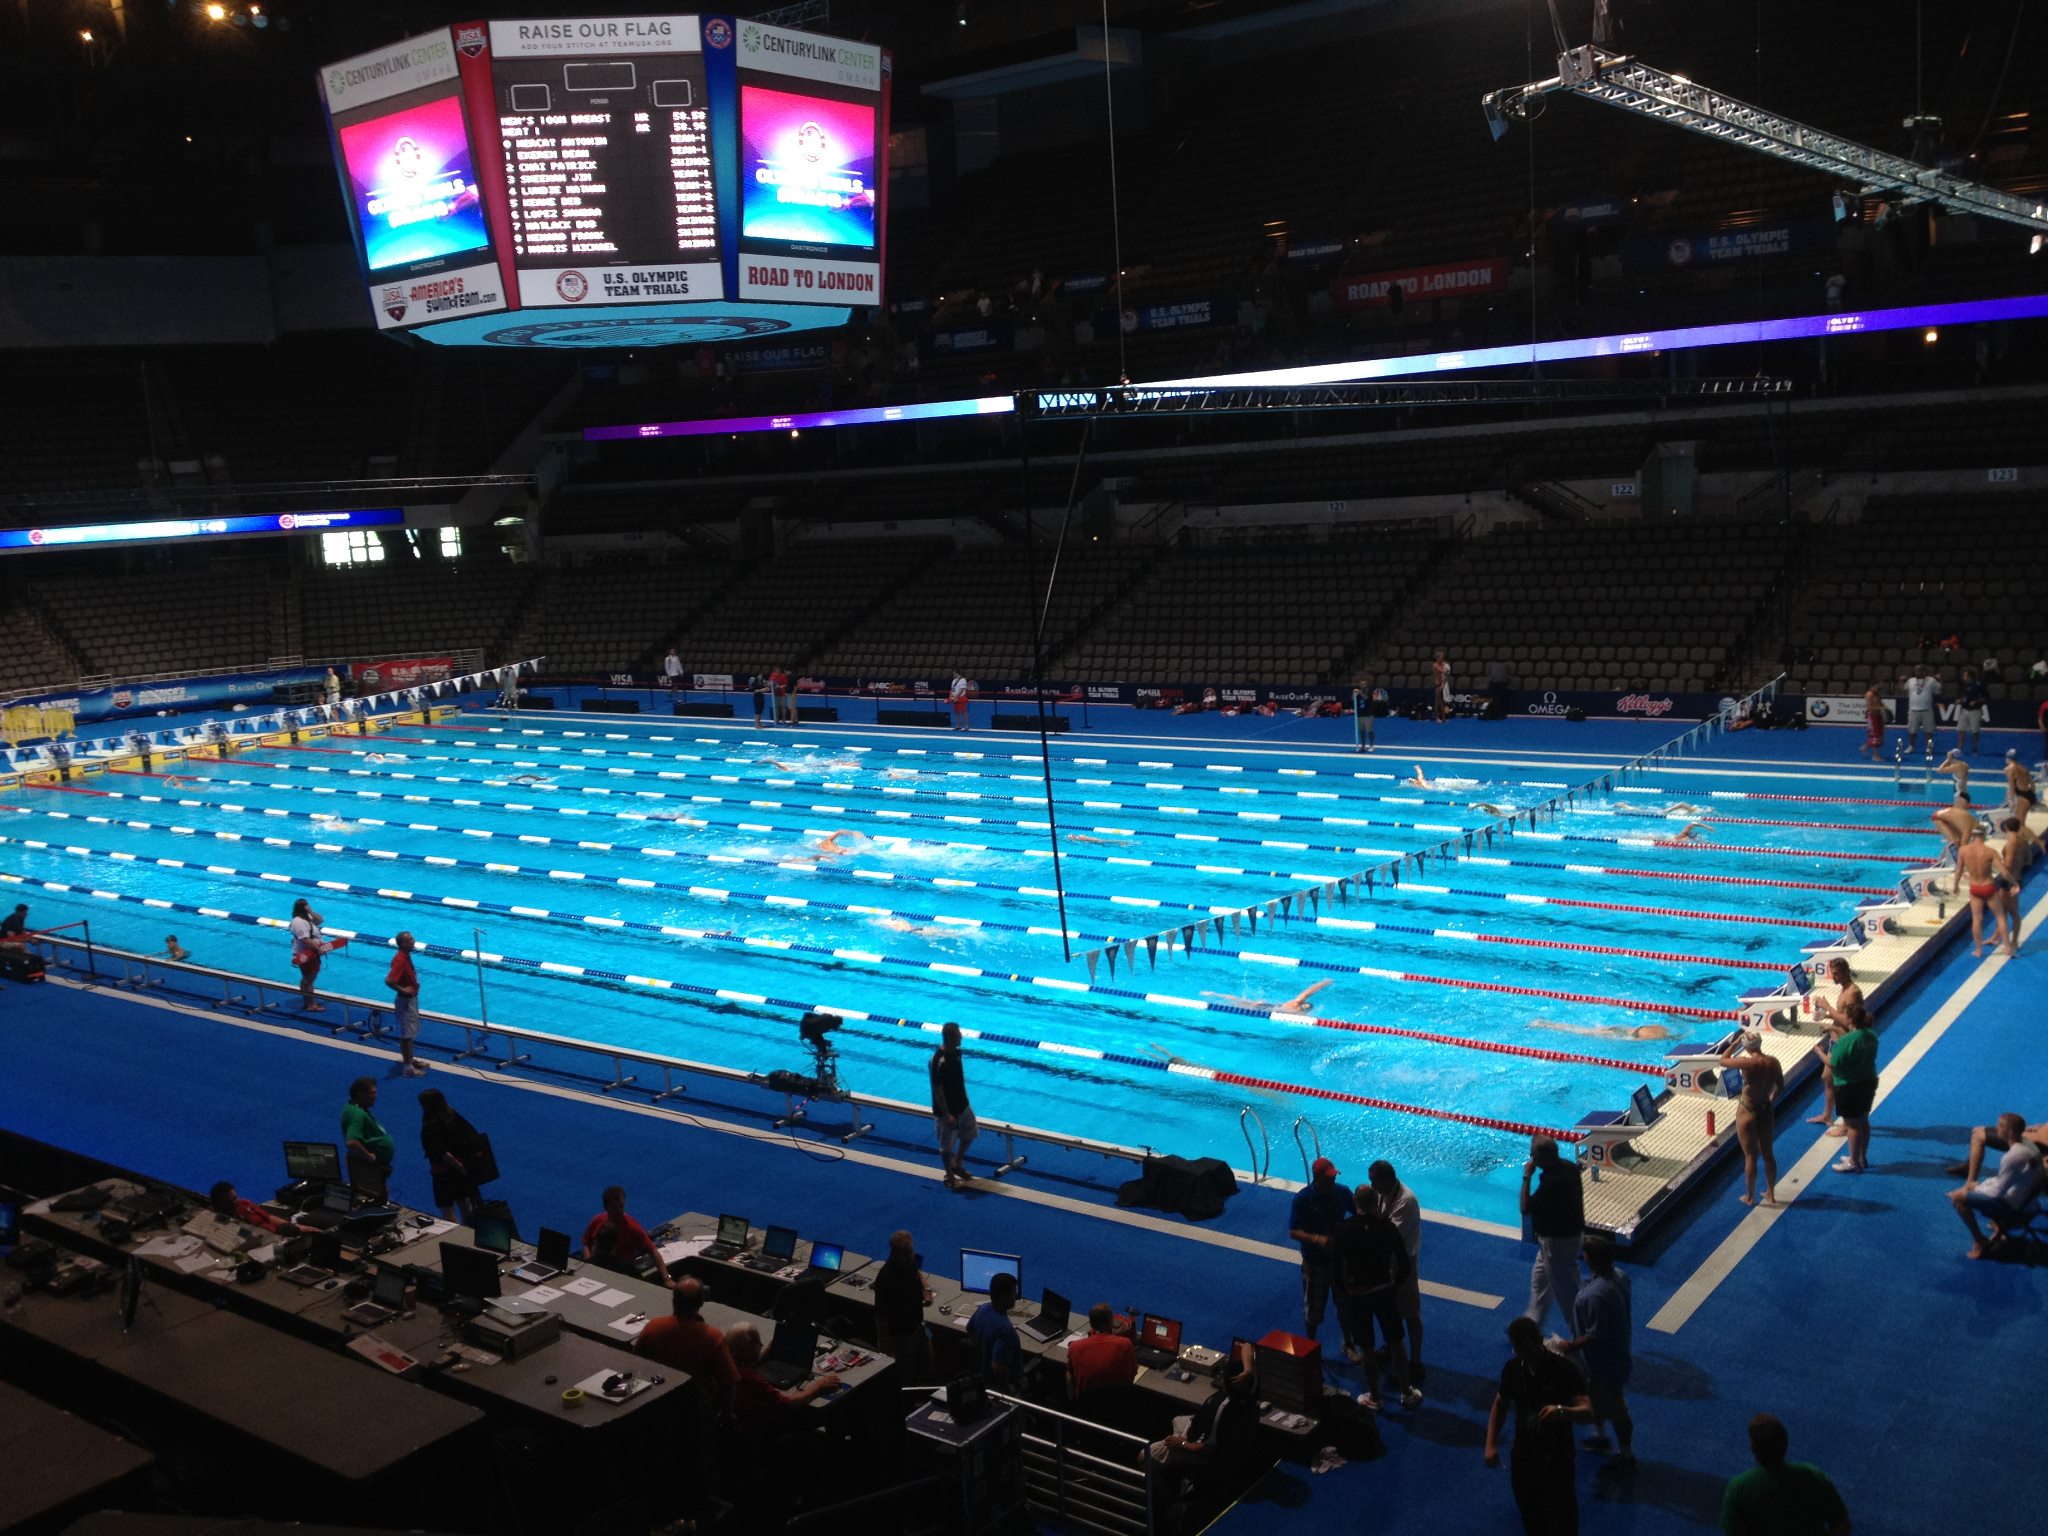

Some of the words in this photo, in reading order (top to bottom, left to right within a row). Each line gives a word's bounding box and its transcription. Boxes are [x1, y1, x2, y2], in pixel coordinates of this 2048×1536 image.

[519, 24, 573, 39] RAISE
[579, 23, 619, 37] OUR
[625, 21, 672, 36] FLAG
[410, 41, 449, 66] CENTER
[838, 48, 875, 70] CENTER
[501, 117, 534, 126] MEN'S
[571, 114, 610, 123] BREAST
[502, 127, 529, 136] HEAT
[506, 164, 514, 172] 2
[550, 161, 597, 170] PATRICK
[507, 176, 515, 184] 3
[510, 199, 518, 207] 5
[511, 211, 519, 219] 6
[524, 209, 558, 219] LOPEZ
[1709, 236, 1729, 248] U.S.
[1736, 229, 1789, 245] OLYMPIC
[515, 246, 523, 254] 9
[1710, 247, 1742, 259] TEAM
[1746, 241, 1789, 256] TRIALS
[603, 273, 628, 284] U.S.
[633, 270, 688, 283] OLYMPIC
[748, 266, 789, 286] ROAD
[794, 269, 813, 288] TO
[818, 271, 874, 291] LONDON
[1397, 278, 1418, 294] TO
[1424, 268, 1492, 291] LONDON
[410, 277, 464, 302] AMERICA'S
[604, 285, 640, 296] TEAM
[644, 283, 689, 295] TRIALS
[1150, 306, 1168, 318] U.S.
[1169, 302, 1210, 315] OLYMPIC
[1151, 317, 1177, 329] TEAM
[1178, 312, 1210, 325] TRIALS
[763, 348, 790, 360] OUR
[793, 345, 825, 358] FLAG
[1993, 470, 2014, 480] 123
[1615, 485, 1633, 495] 122
[1329, 502, 1344, 511] 121
[610, 674, 633, 683] VISA
[1451, 693, 1472, 703] NBC
[1528, 704, 1572, 714] OMEGA
[1617, 694, 1673, 716] Kellogg's
[1868, 919, 1877, 931] 5
[1815, 962, 1825, 975] 6
[1753, 1013, 1763, 1027] 7
[1680, 1073, 1691, 1088] 8
[1591, 1144, 1604, 1160] 9
